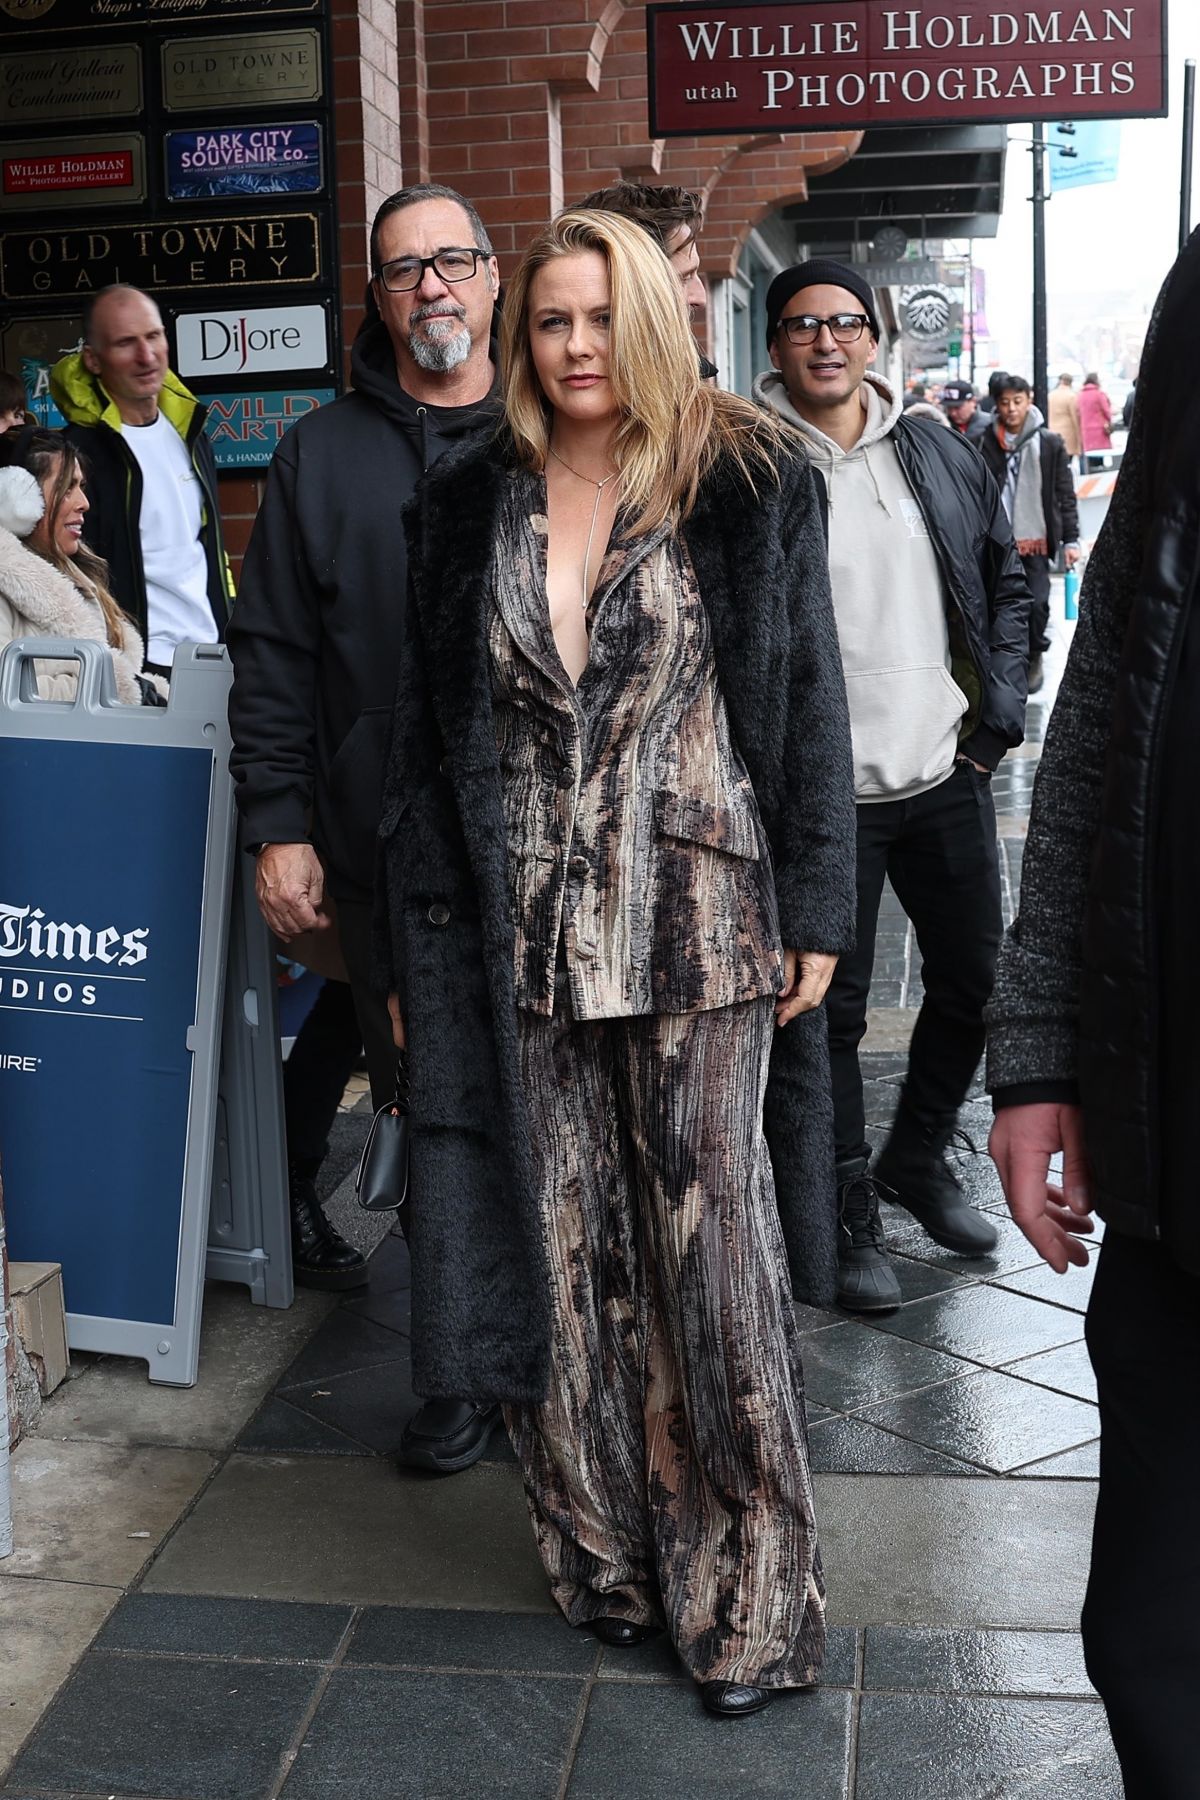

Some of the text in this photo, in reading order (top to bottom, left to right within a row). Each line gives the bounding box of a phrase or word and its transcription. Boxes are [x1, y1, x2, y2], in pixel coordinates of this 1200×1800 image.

[678, 8, 1134, 61] WILLIE HOLDMAN
[173, 50, 309, 75] OLD TOWNE
[5, 63, 58, 87] Grand
[174, 70, 309, 91] GALLERY
[685, 61, 1135, 109] utah PHOTOGRAPHS
[196, 130, 293, 151] PARK CITY
[9, 159, 124, 177] WILLIE HOLDMAN
[181, 147, 277, 168] SOUVENIR
[30, 175, 87, 186] PHOTOGRAPHS
[88, 172, 124, 182] GALLERY
[28, 222, 287, 264] OLD TOWNE
[32, 256, 289, 291] GALLERY
[34, 403, 49, 413] SKI
[226, 453, 235, 463] &
[0, 903, 149, 967] Times
[0, 977, 97, 1006] DIOS
